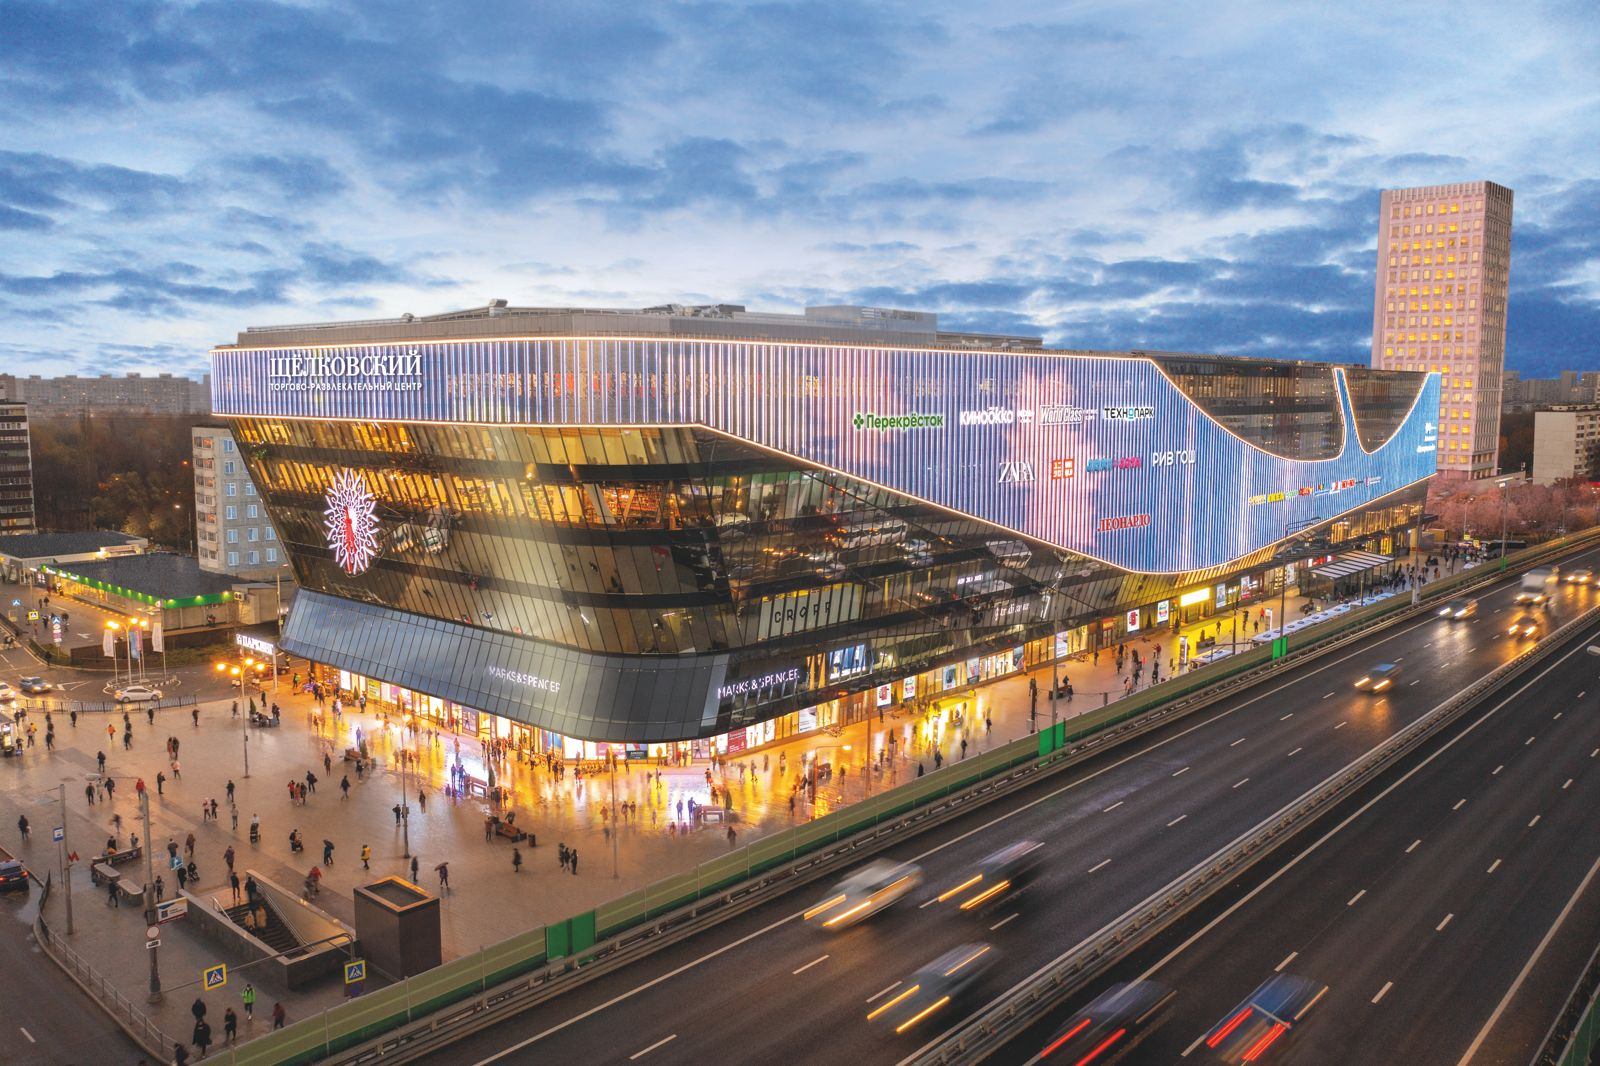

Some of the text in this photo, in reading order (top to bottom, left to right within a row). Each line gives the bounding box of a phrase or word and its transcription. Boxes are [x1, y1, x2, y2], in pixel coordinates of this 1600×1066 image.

[270, 350, 422, 381] ЩЁЛКОВСКИЙ
[270, 381, 422, 391] ТОРГОВО-РАЗВЛЕКАТЕЛЬНЫЙ ЦЕНТР
[866, 413, 943, 431] Перекрёсток
[1041, 406, 1063, 423] World
[1063, 406, 1083, 422] Class
[1104, 407, 1154, 419] ТЕХНОПАРК
[1152, 449, 1196, 467] РИВ ГОШ
[998, 462, 1035, 483] ZARA
[1097, 513, 1151, 532] ЛЕОНАРДО
